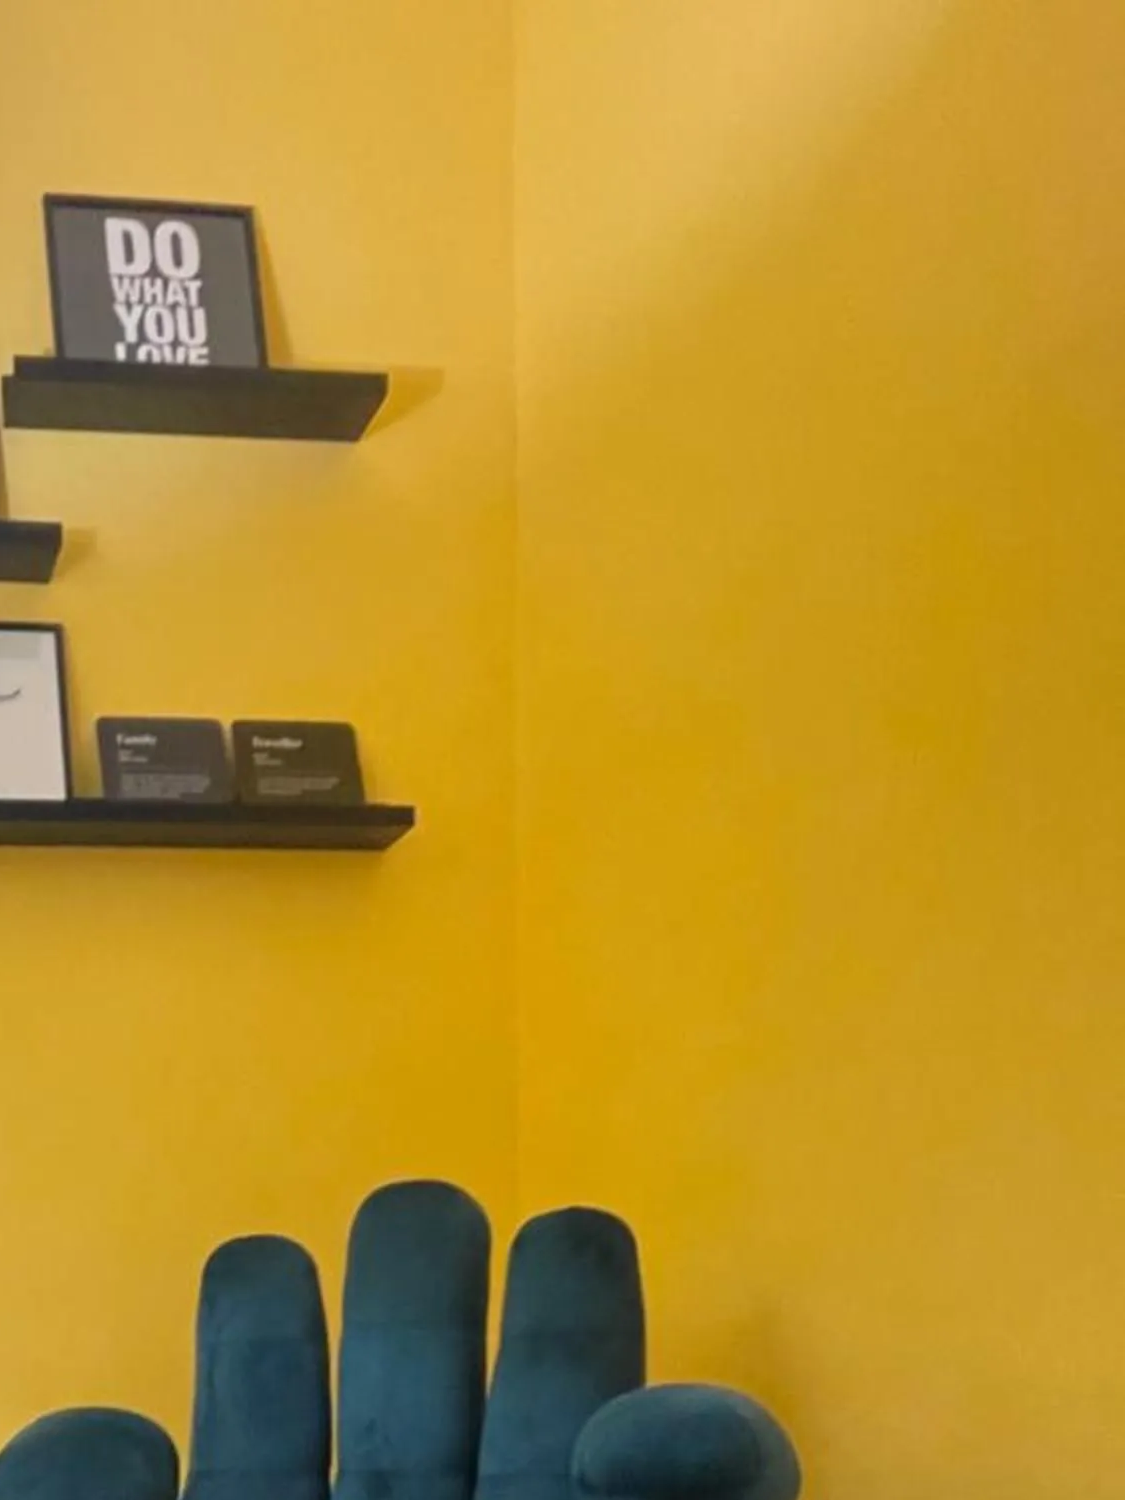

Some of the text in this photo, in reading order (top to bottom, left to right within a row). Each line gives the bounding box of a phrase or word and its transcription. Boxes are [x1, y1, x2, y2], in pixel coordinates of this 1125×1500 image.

[104, 216, 201, 279] DO
[110, 275, 203, 307] WHAT
[112, 302, 208, 347] YOU
